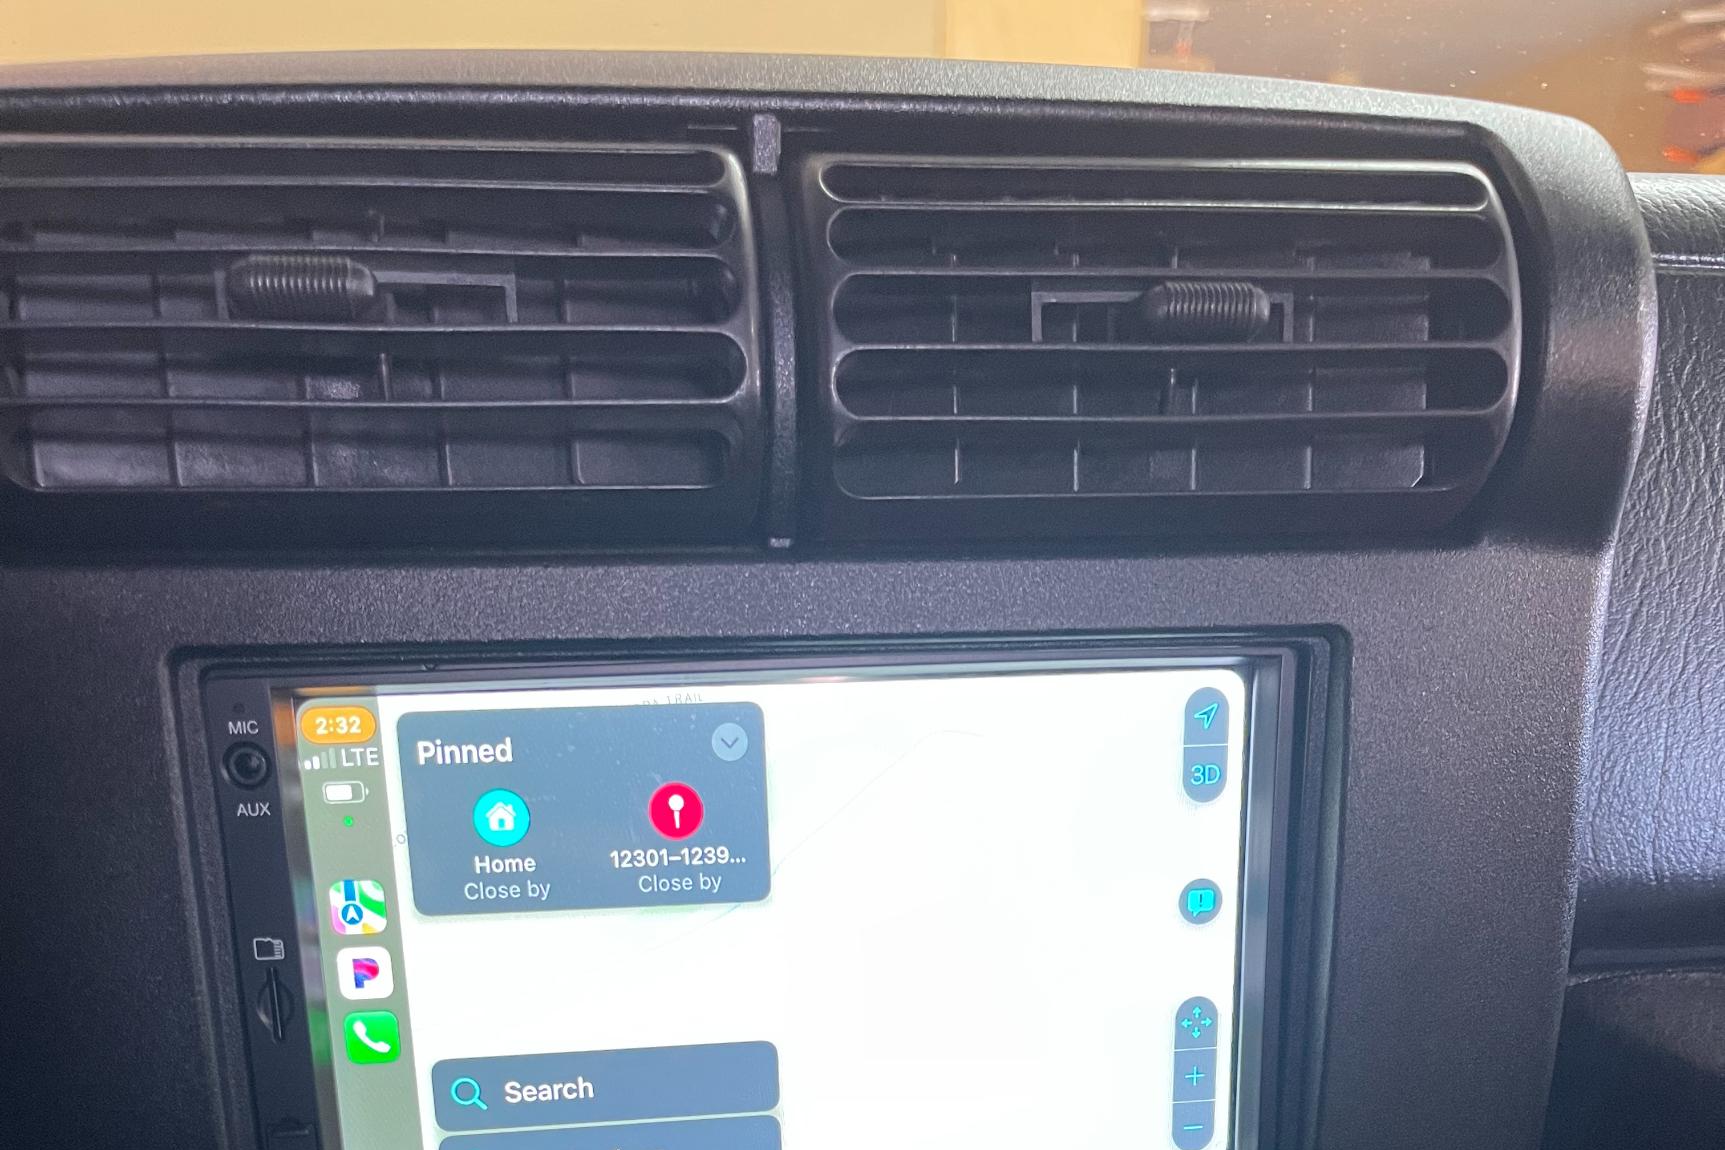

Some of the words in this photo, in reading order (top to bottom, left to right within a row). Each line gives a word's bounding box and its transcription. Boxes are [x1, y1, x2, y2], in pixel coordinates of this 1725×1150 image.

[228, 720, 259, 735] MIC
[315, 716, 361, 735] 2:32
[341, 747, 379, 767] LTE
[417, 737, 513, 765] Pinned
[1191, 764, 1221, 785] 3D
[237, 803, 271, 817] AUX
[474, 855, 537, 874] Home
[464, 882, 521, 900] Close
[527, 879, 551, 901] by
[638, 874, 693, 893] Close
[699, 872, 722, 893] by
[504, 1076, 594, 1104] Search
